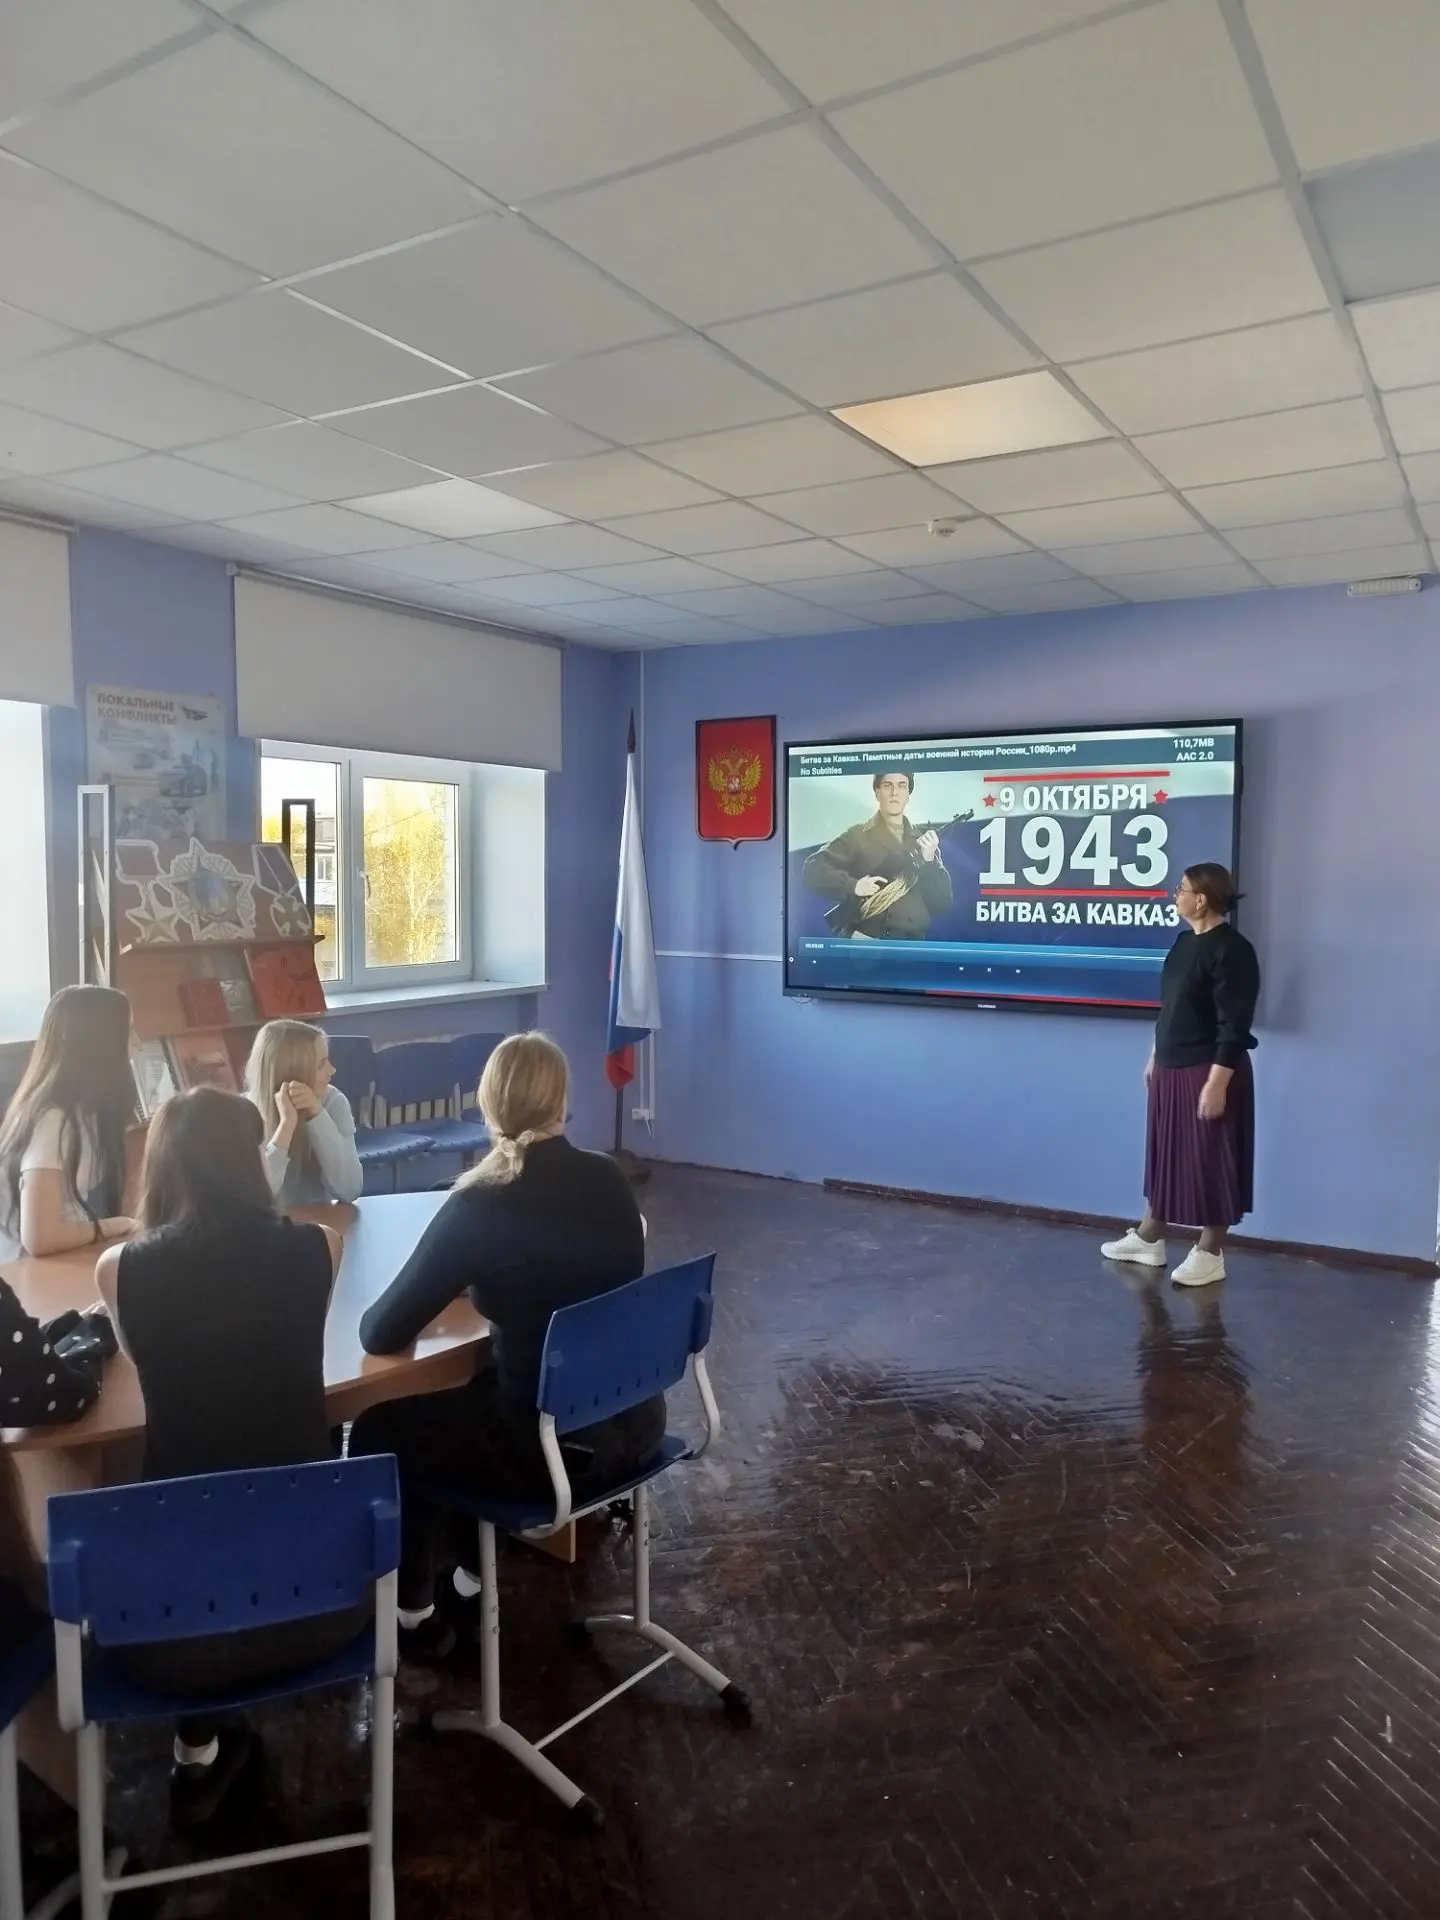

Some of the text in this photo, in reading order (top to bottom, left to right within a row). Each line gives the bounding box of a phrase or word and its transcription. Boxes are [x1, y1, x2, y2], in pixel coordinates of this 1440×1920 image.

[97, 692, 175, 712] ЛОКАЛЬНЫЕ
[97, 706, 178, 725] КОНФЛИКТЫ
[1173, 738, 1215, 749] 110,7MB
[823, 756, 832, 764] за
[862, 753, 902, 762] Памятные
[903, 752, 925, 761] даты
[960, 748, 994, 758] истории
[1176, 751, 1214, 762] AAC 2.0
[800, 766, 843, 776] No Subtitles
[1000, 783, 1147, 811] 9 ОКТЯБРЯ
[979, 814, 1169, 887] 1943
[976, 901, 1180, 927] БИТВА ЗА КАВКАЗ
